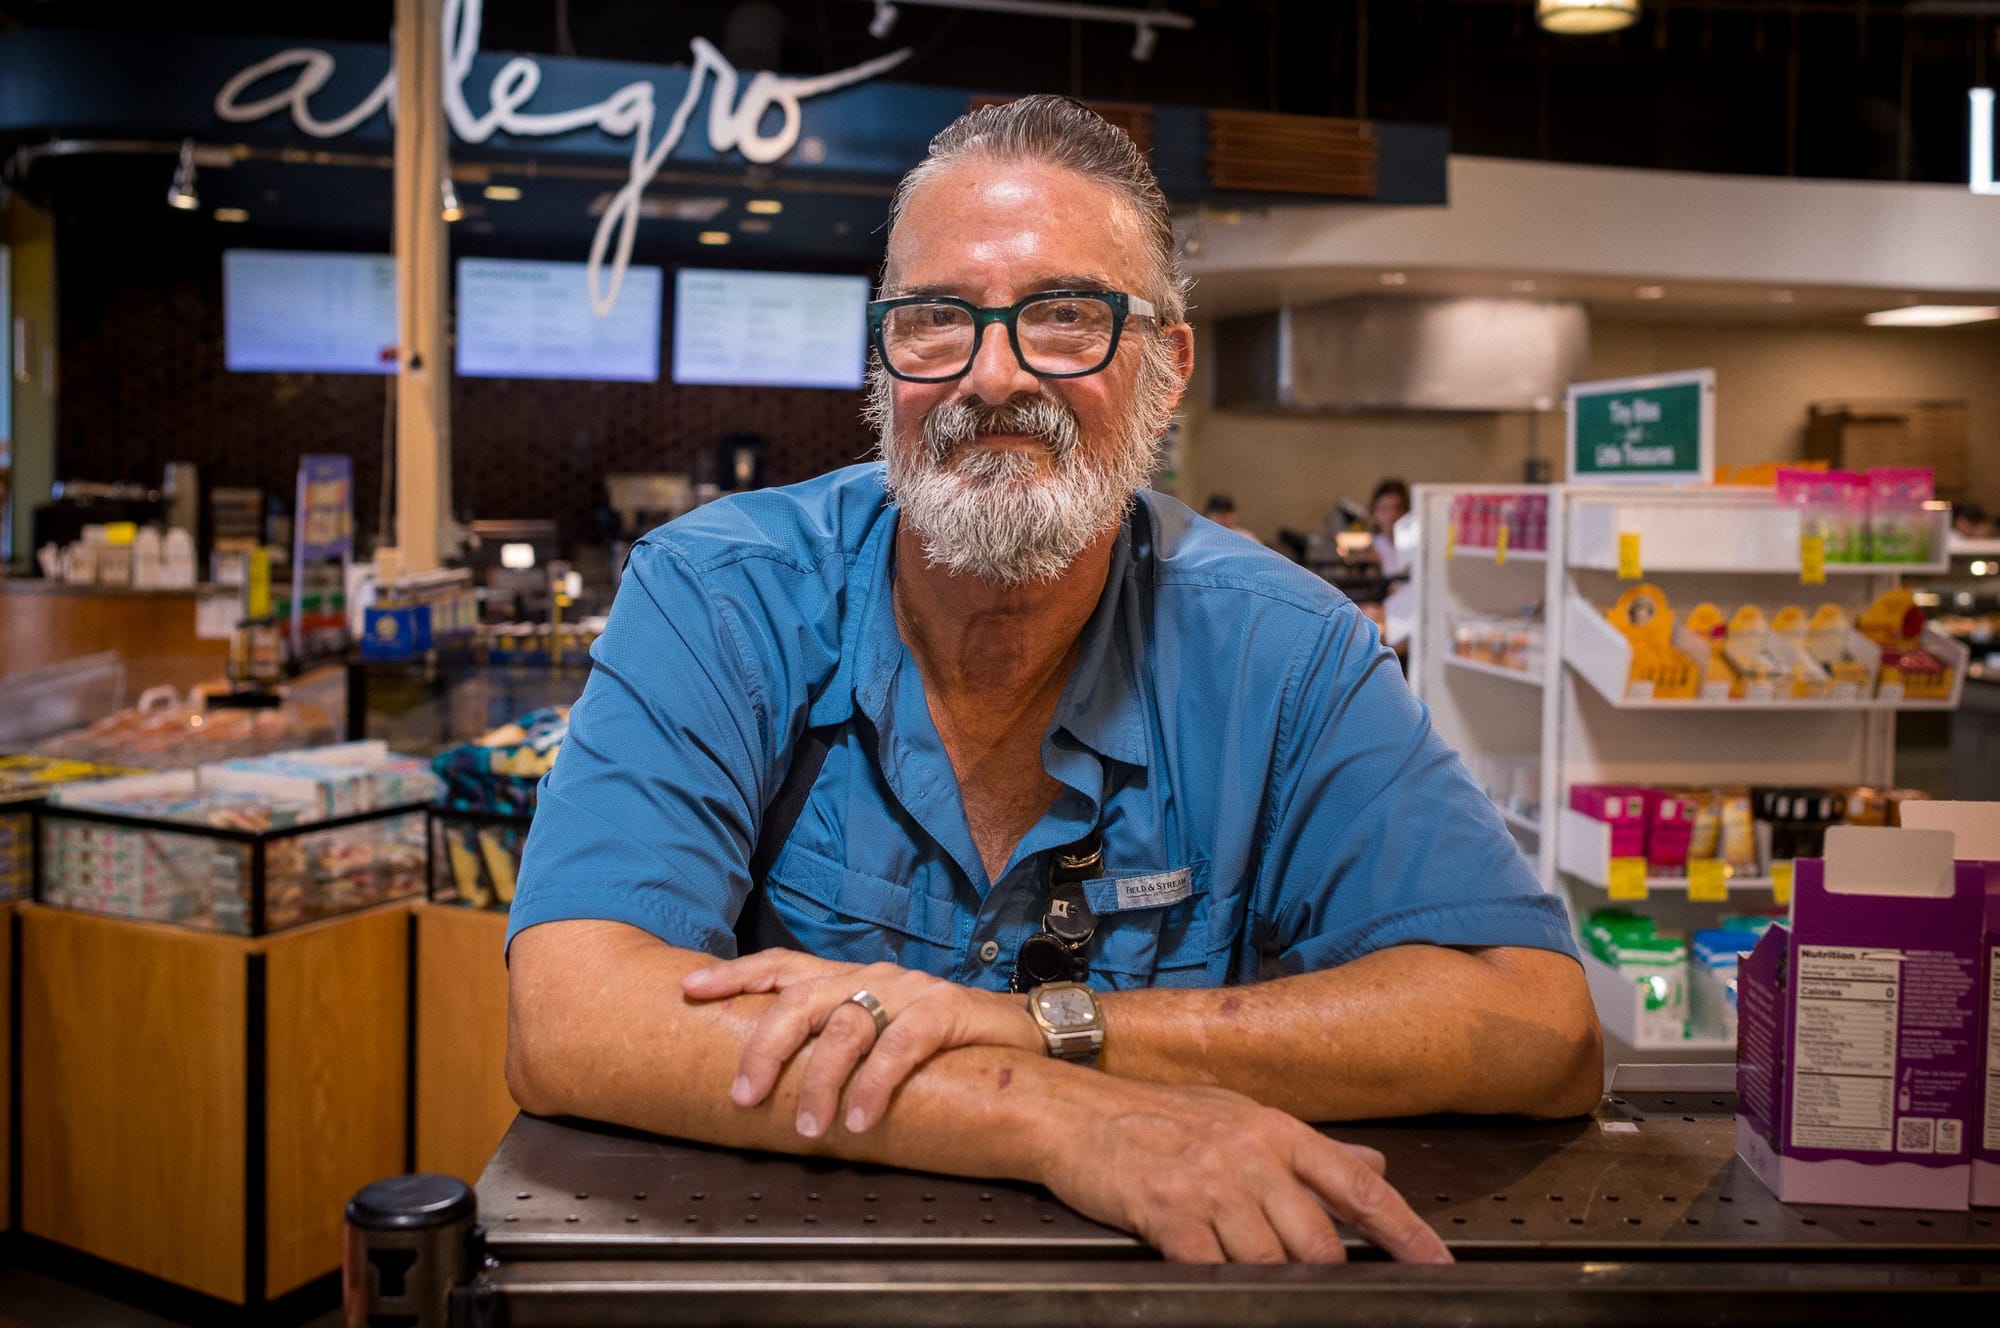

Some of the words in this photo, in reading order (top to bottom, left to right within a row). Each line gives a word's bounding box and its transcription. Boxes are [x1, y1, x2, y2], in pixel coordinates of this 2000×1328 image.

[1148, 883, 1155, 891] &
[1801, 949, 1856, 960] Nutrition
[1800, 987, 1842, 997] Calories
[1886, 987, 1895, 998] 0
